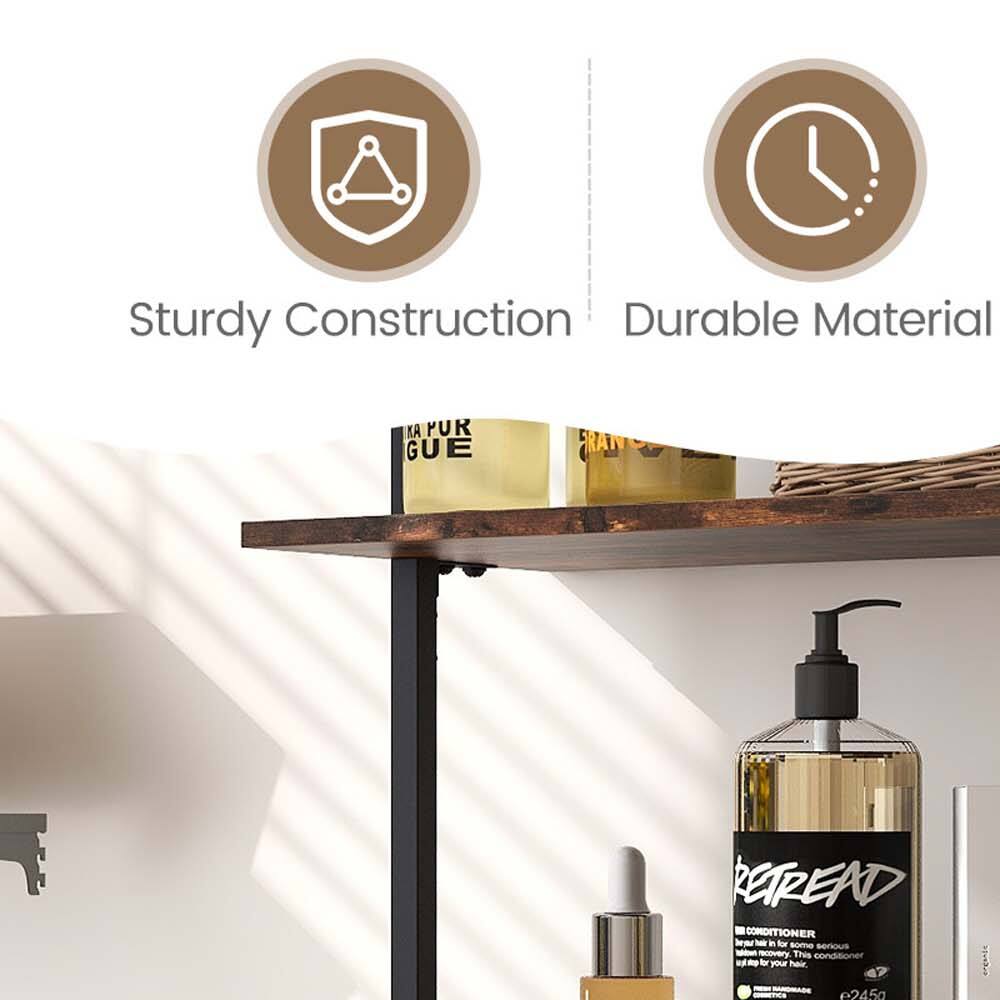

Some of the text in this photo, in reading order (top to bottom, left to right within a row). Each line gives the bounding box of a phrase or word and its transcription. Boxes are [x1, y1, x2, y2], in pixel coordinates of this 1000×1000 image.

[407, 437, 473, 461] GUE
[734, 854, 907, 908] RETREAD
[746, 926, 816, 938] CONDITIONER
[768, 939, 776, 947] in
[777, 940, 788, 948] for
[816, 942, 850, 950] serious
[793, 949, 812, 959] This
[813, 951, 864, 960] conditioner
[770, 960, 788, 968] your
[789, 960, 808, 968] hair.
